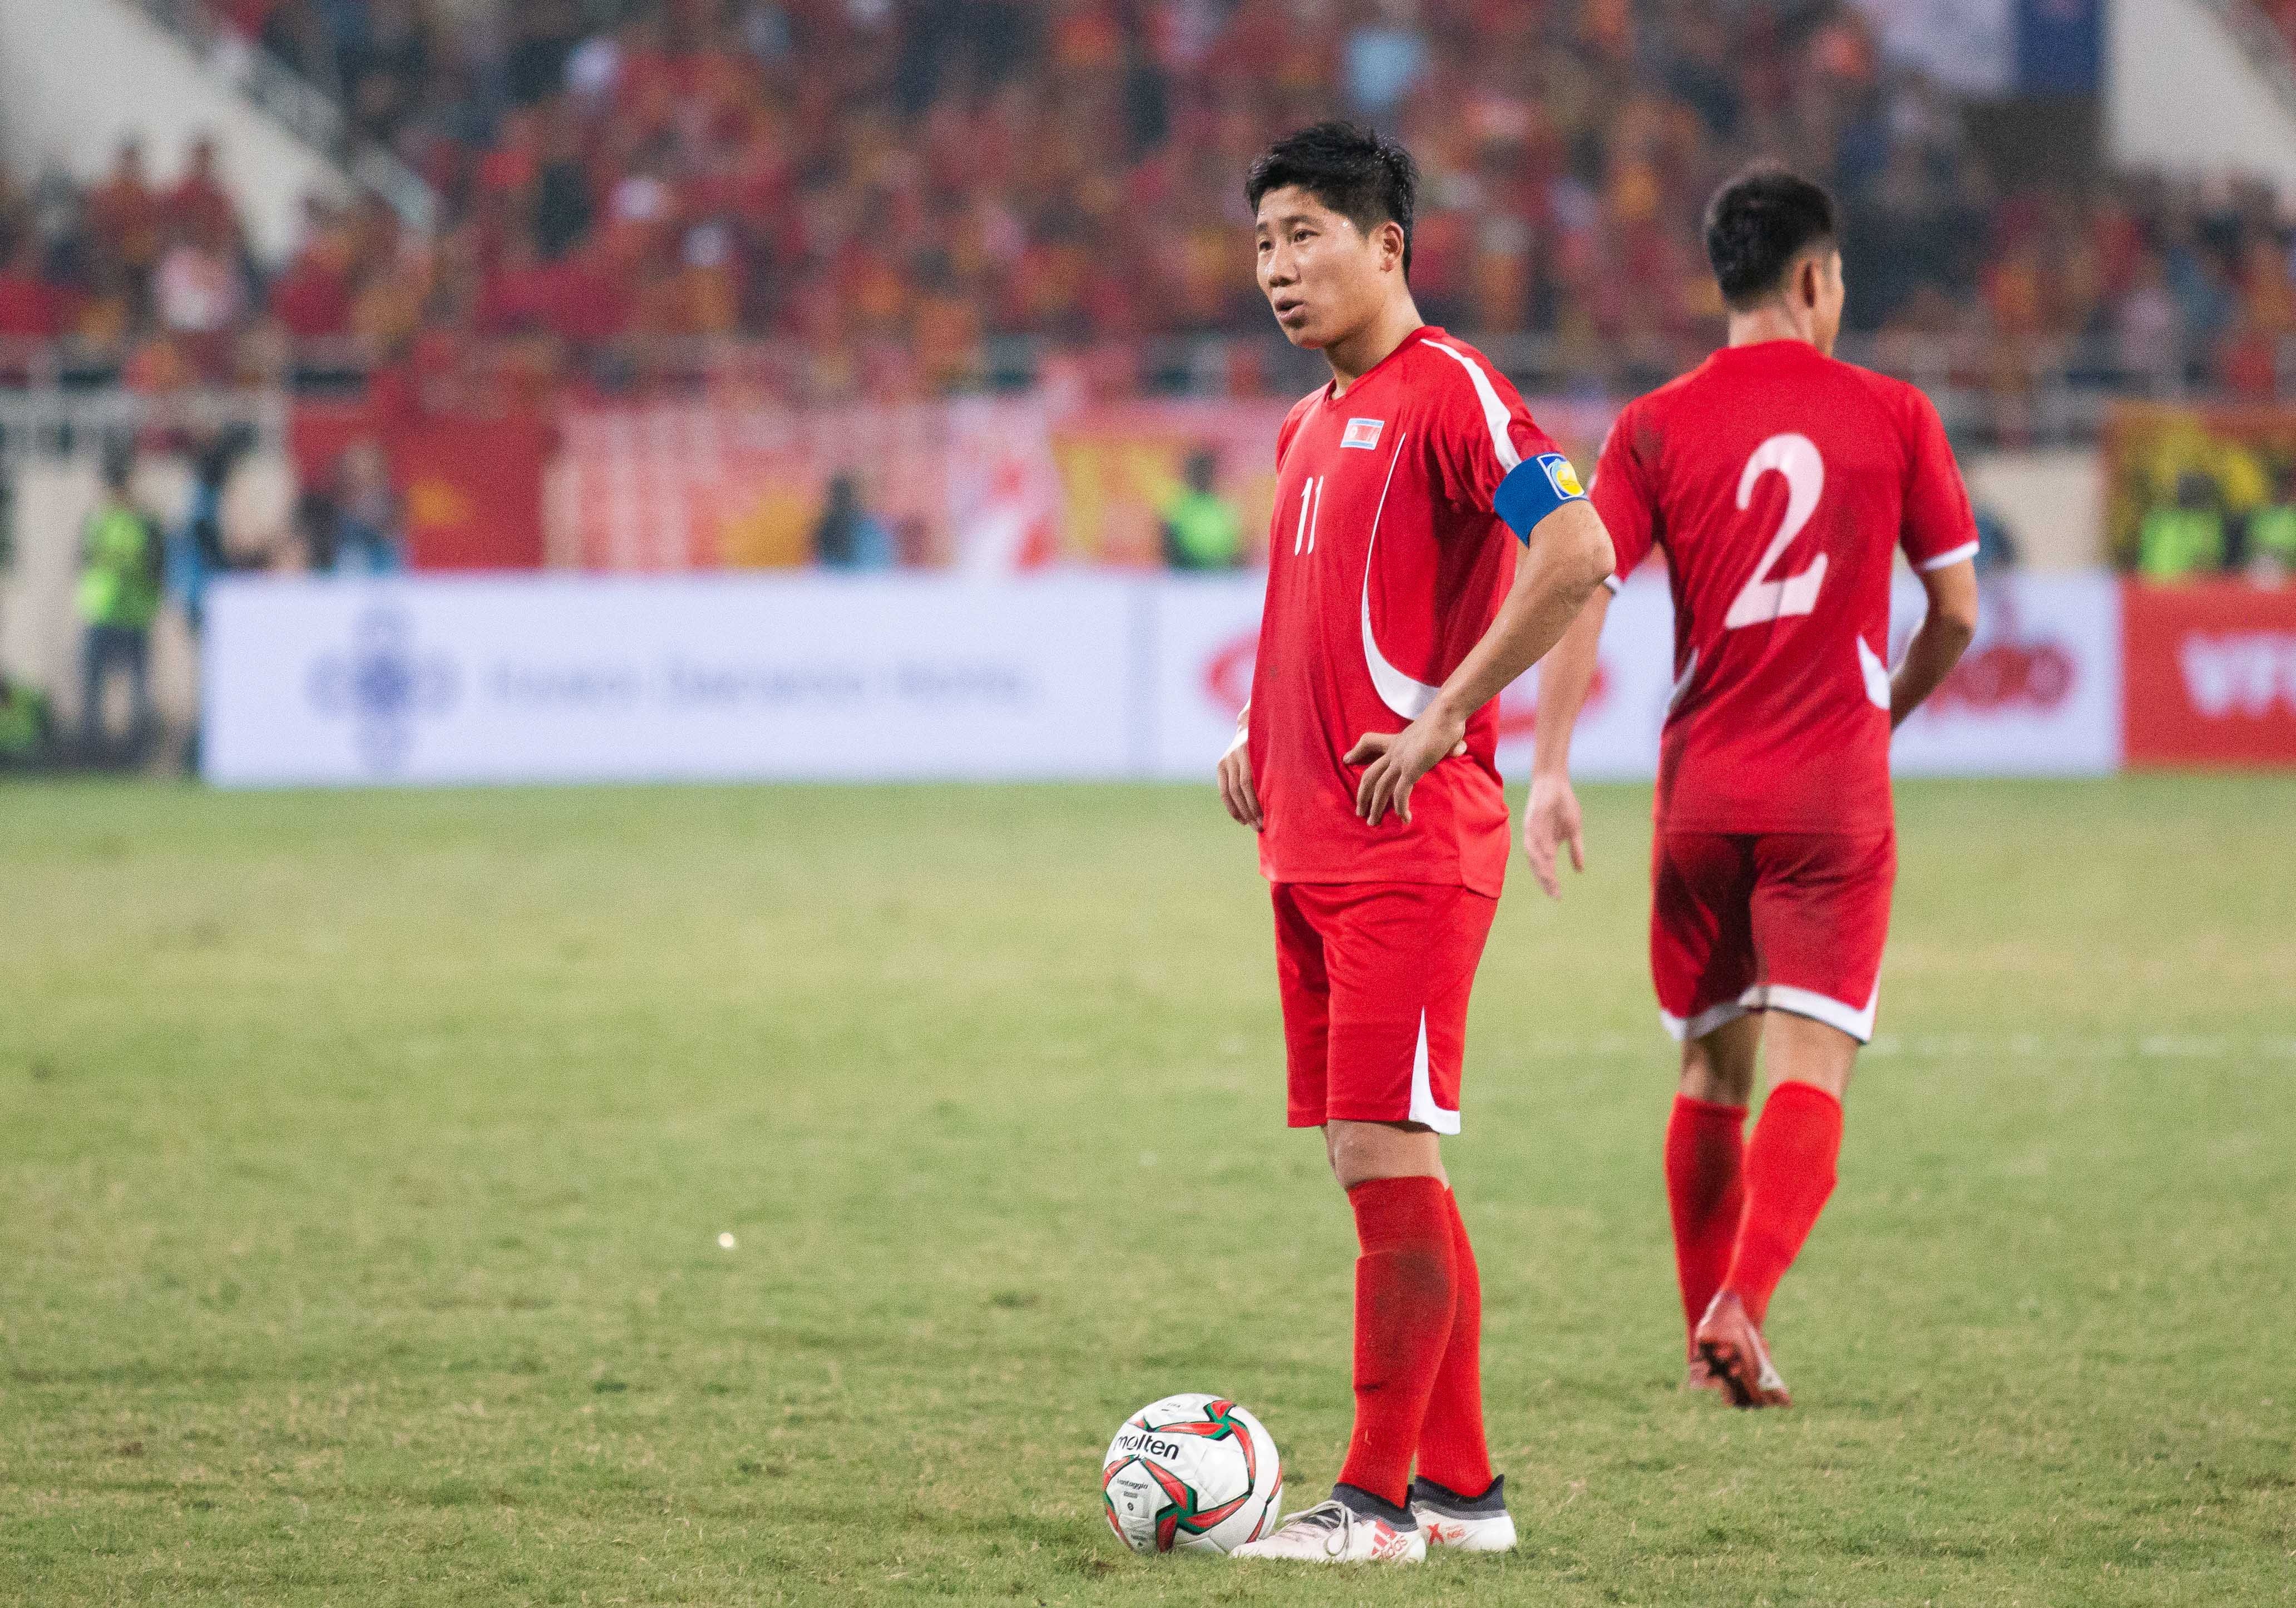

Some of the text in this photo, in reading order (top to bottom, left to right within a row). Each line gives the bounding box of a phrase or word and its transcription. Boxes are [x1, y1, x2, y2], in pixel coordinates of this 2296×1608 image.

[1295, 475, 1324, 556] 11
[1724, 432, 1829, 629] 2
[1113, 1434, 1179, 1459] molten
